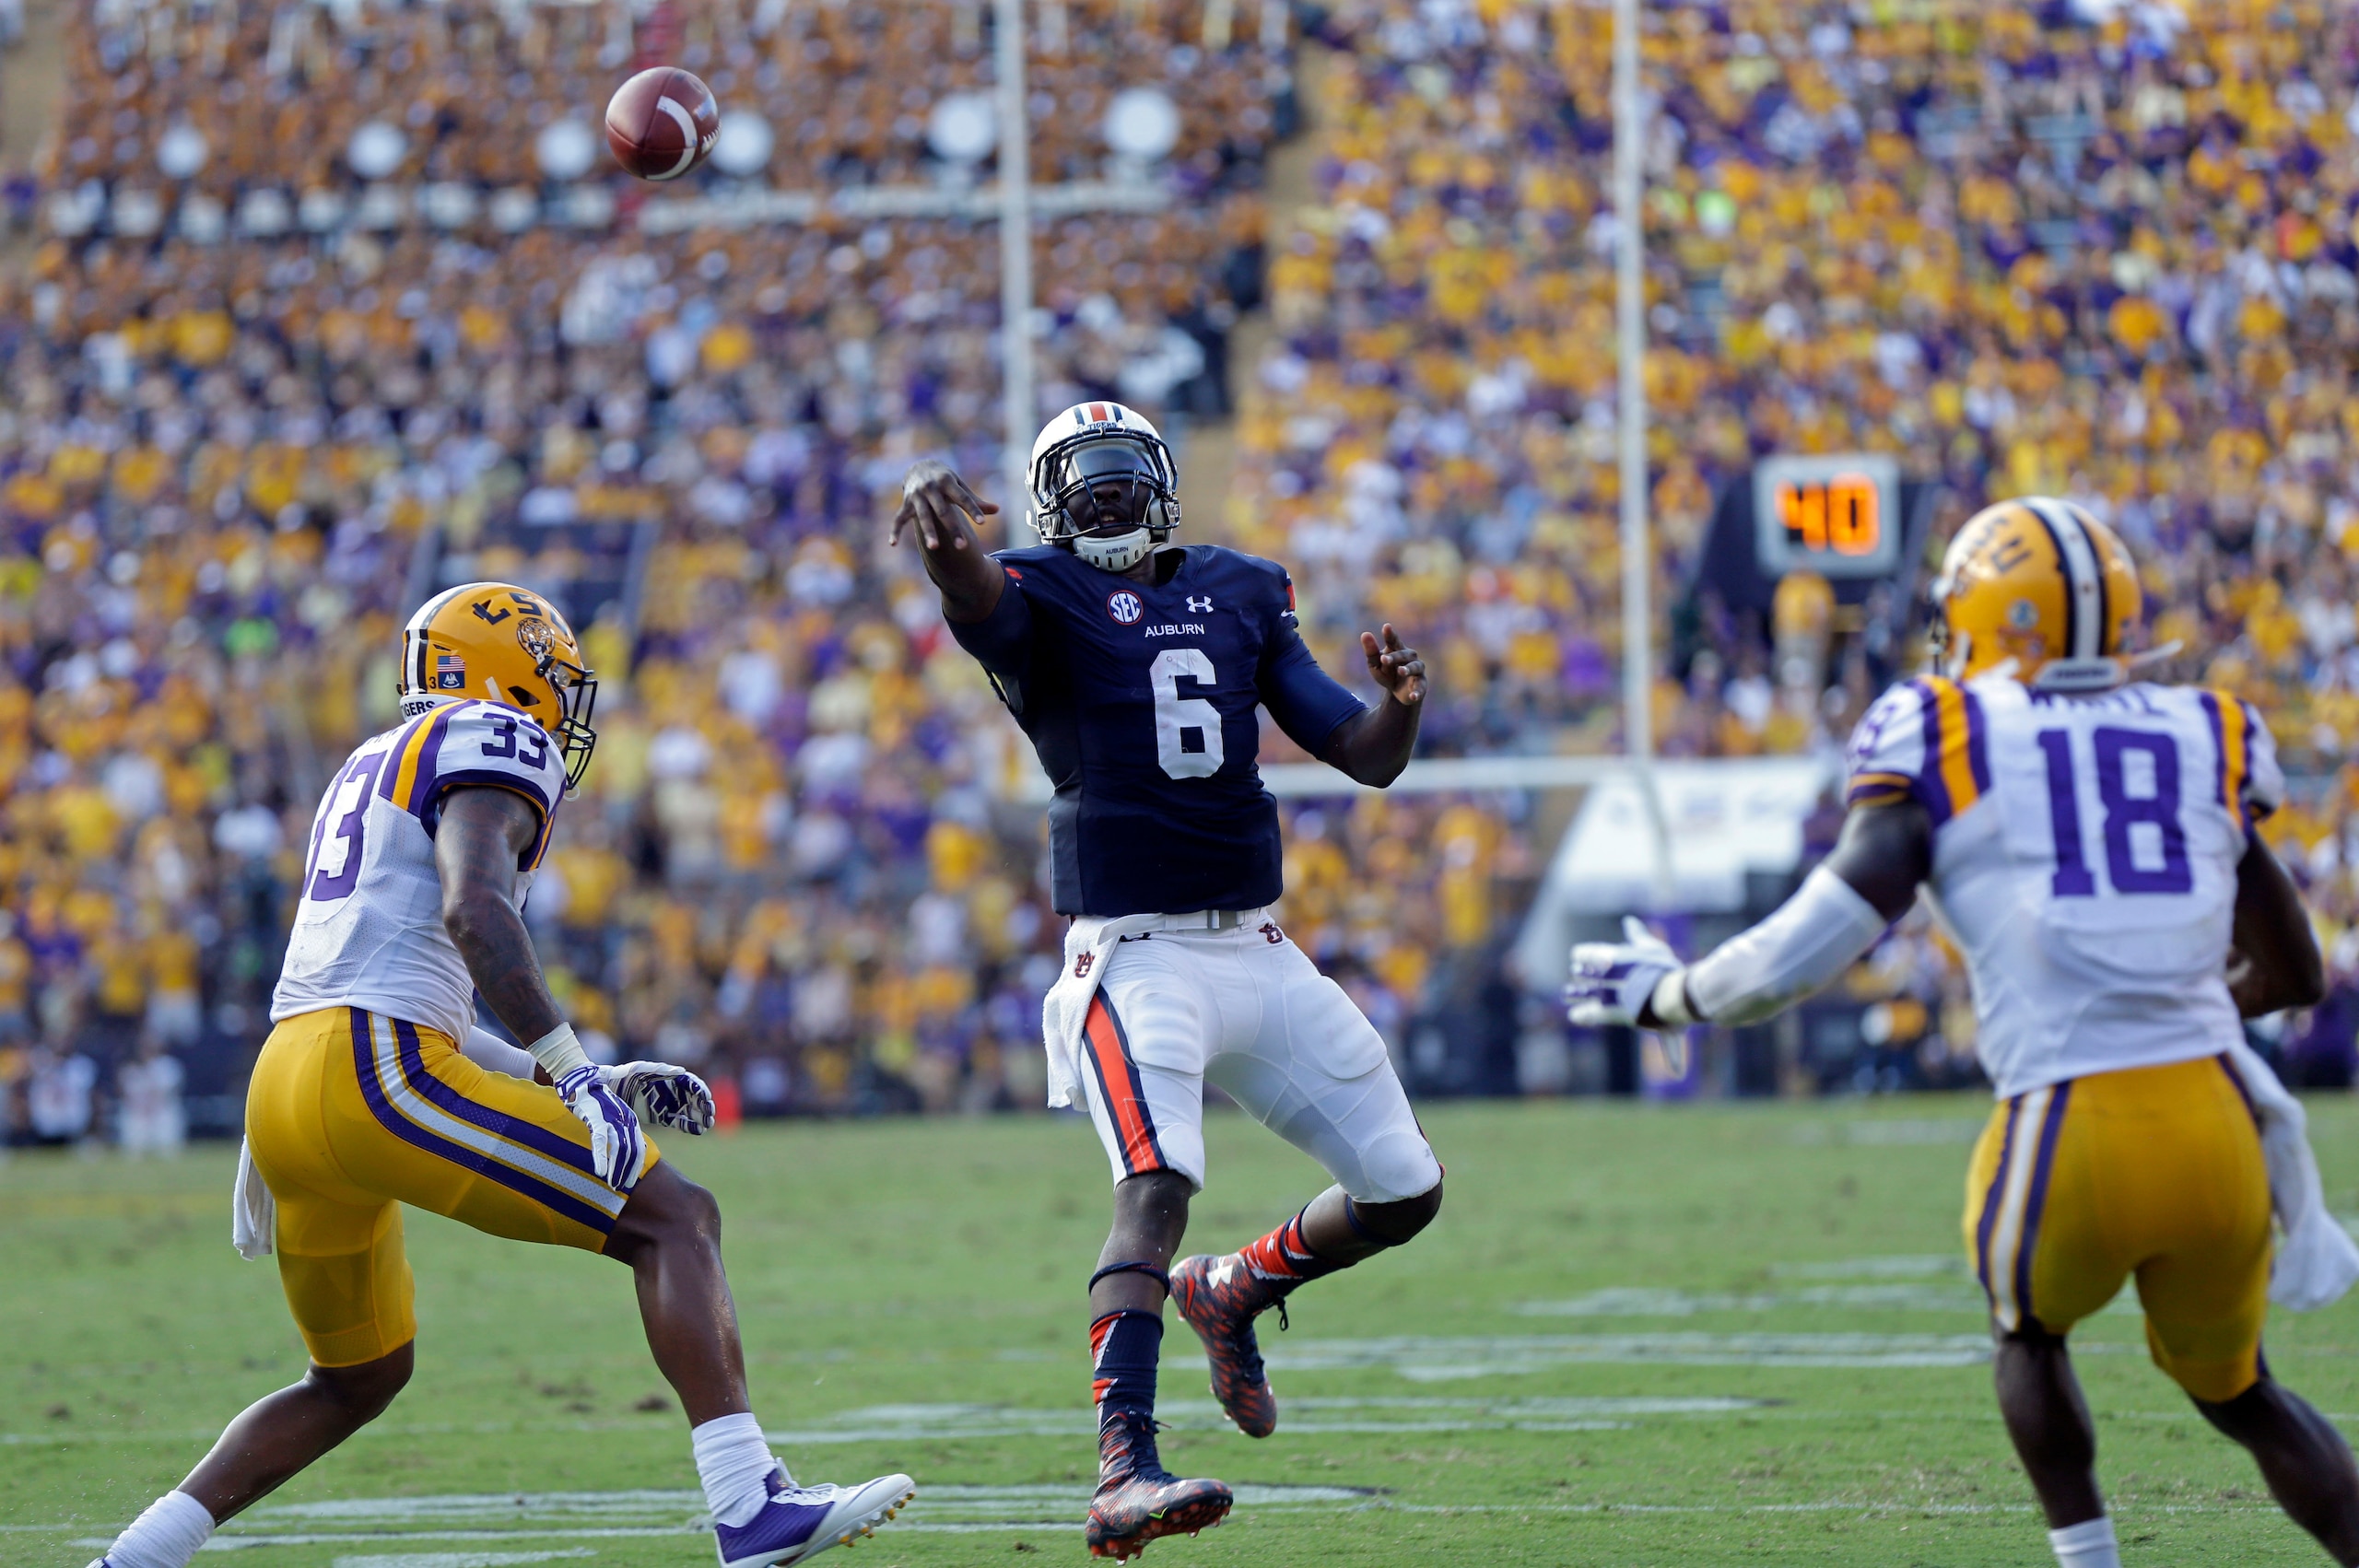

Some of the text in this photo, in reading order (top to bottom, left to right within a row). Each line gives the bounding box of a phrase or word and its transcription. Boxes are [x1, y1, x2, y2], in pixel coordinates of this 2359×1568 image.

[1774, 474, 1880, 556] 40
[1105, 545, 1129, 555] AUBURN
[1109, 592, 1142, 623] SEC
[1144, 623, 1205, 638] AUBURN
[428, 676, 437, 689] 3
[1149, 649, 1225, 780] 6
[481, 711, 549, 771] 33
[2036, 726, 2193, 896] 18
